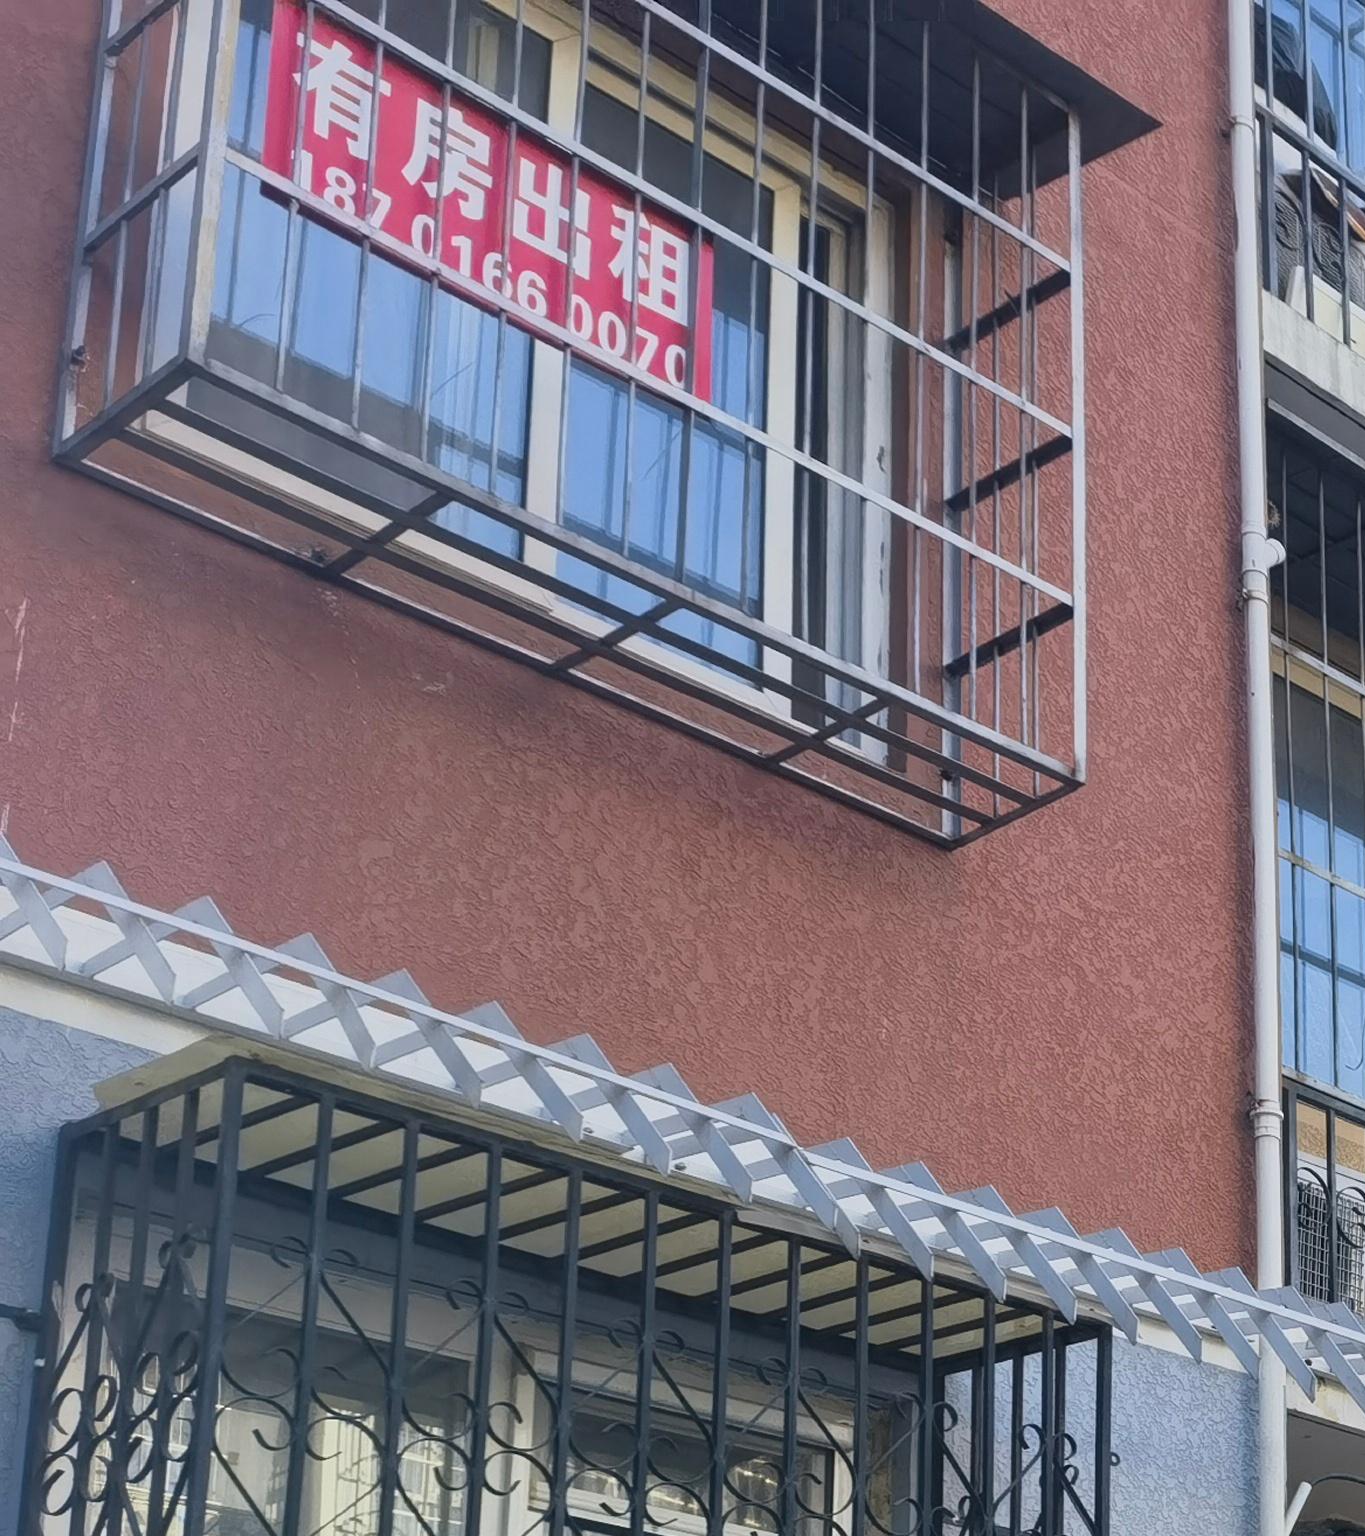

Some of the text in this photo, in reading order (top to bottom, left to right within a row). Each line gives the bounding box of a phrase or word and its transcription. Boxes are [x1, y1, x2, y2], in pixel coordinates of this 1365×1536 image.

[293, 33, 689, 327] 有房出租
[411, 213, 548, 319] 0166
